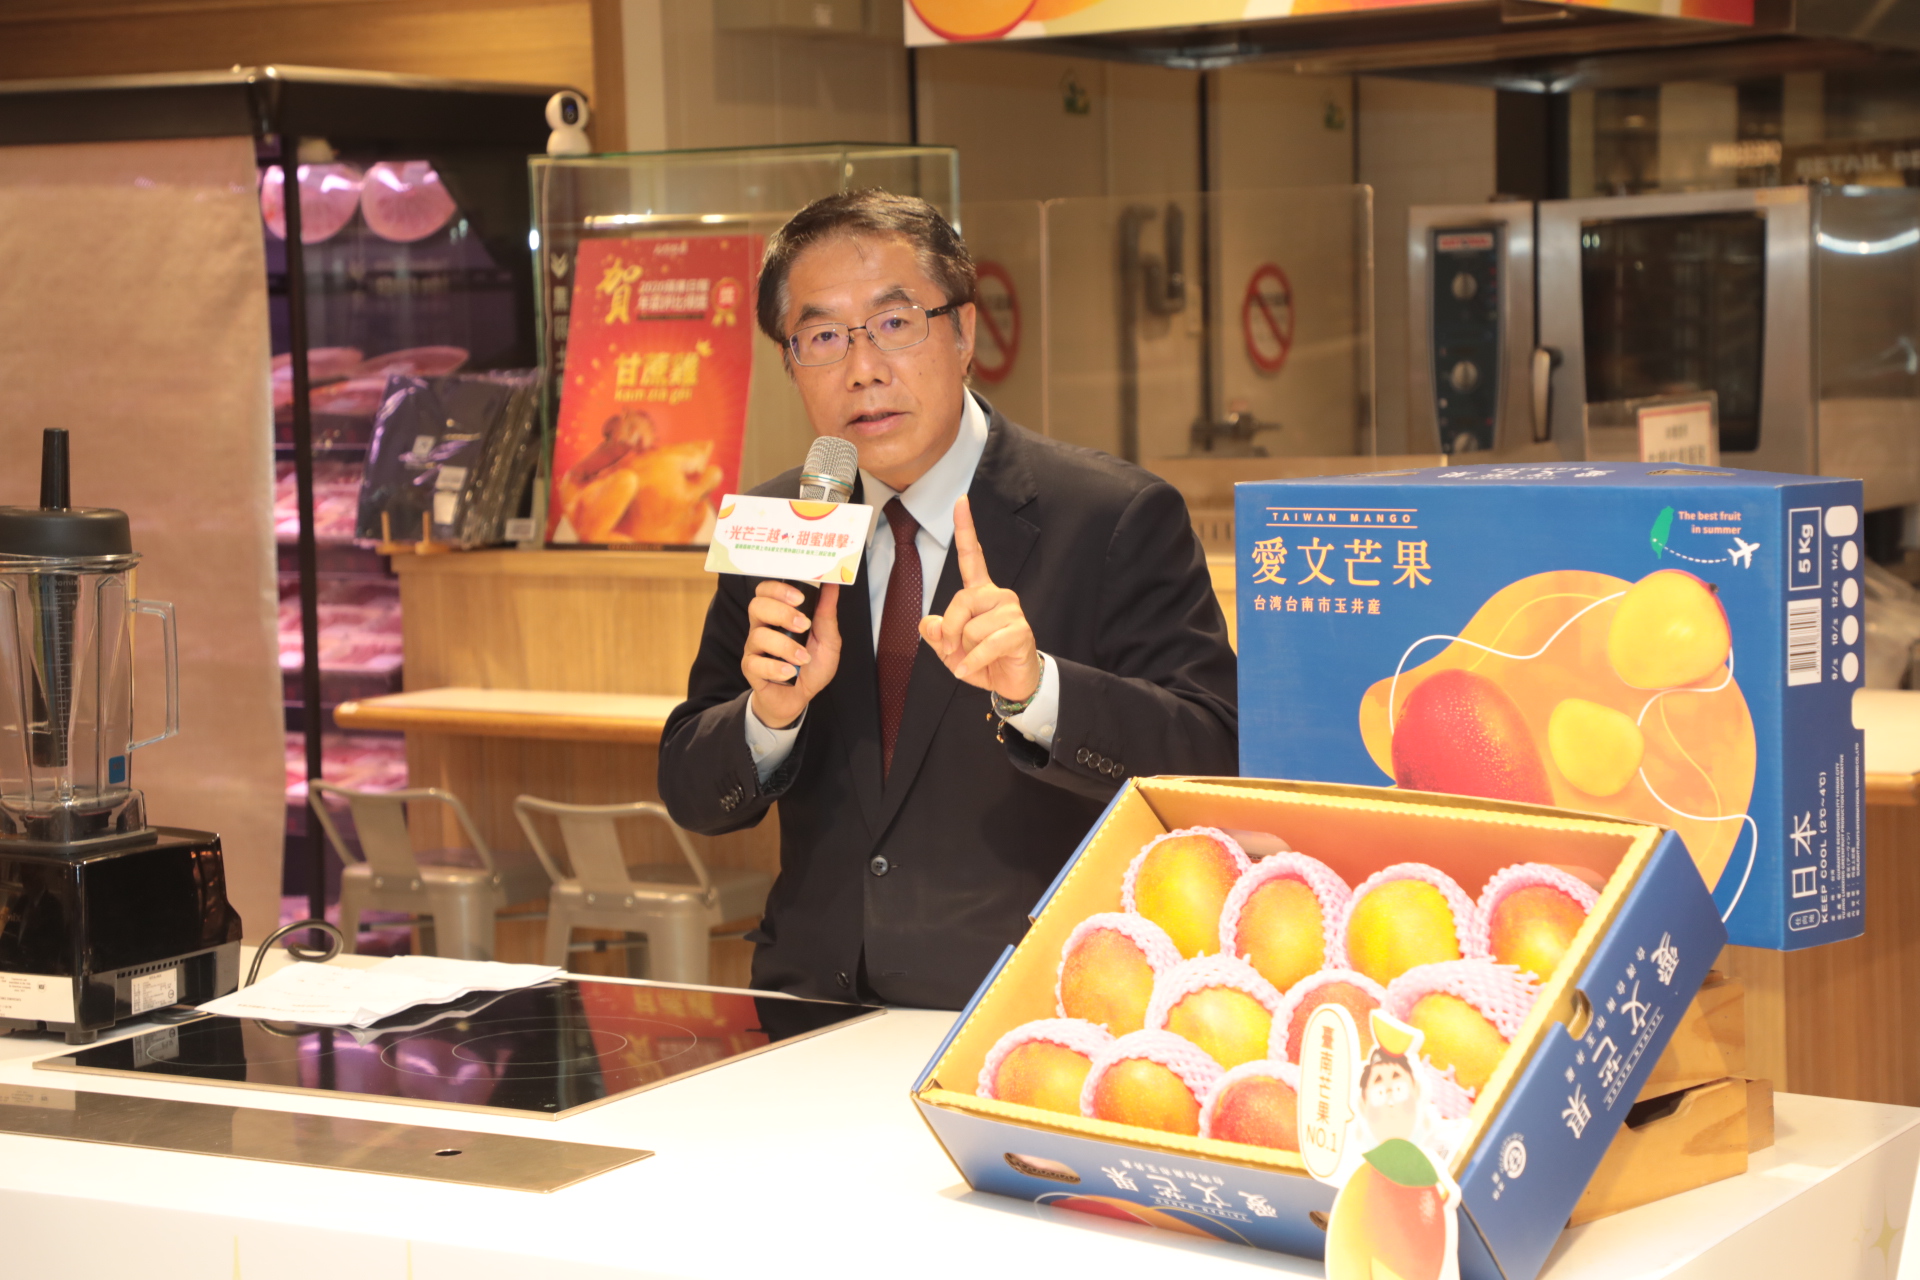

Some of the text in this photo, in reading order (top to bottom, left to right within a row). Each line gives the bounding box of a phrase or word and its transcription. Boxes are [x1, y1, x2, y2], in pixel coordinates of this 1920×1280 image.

[595, 256, 644, 325] 賀
[1272, 512, 1412, 523] TAIWAN MANGO
[1678, 511, 1742, 521] The best fruit
[1691, 525, 1742, 535] in summer
[728, 525, 850, 549] 光芒三越 甜蜜爆擊
[1798, 524, 1814, 573] 5 Kg
[1252, 536, 1432, 589] 愛文芒果
[1790, 811, 1818, 899] 日本
[1820, 839, 1829, 879] COOL
[1820, 884, 1829, 923] KEEP
[1562, 931, 1680, 1139] 愛文芒果
[1306, 1123, 1337, 1153] NO.1
[1101, 1166, 1279, 1218] 愛文芒果
